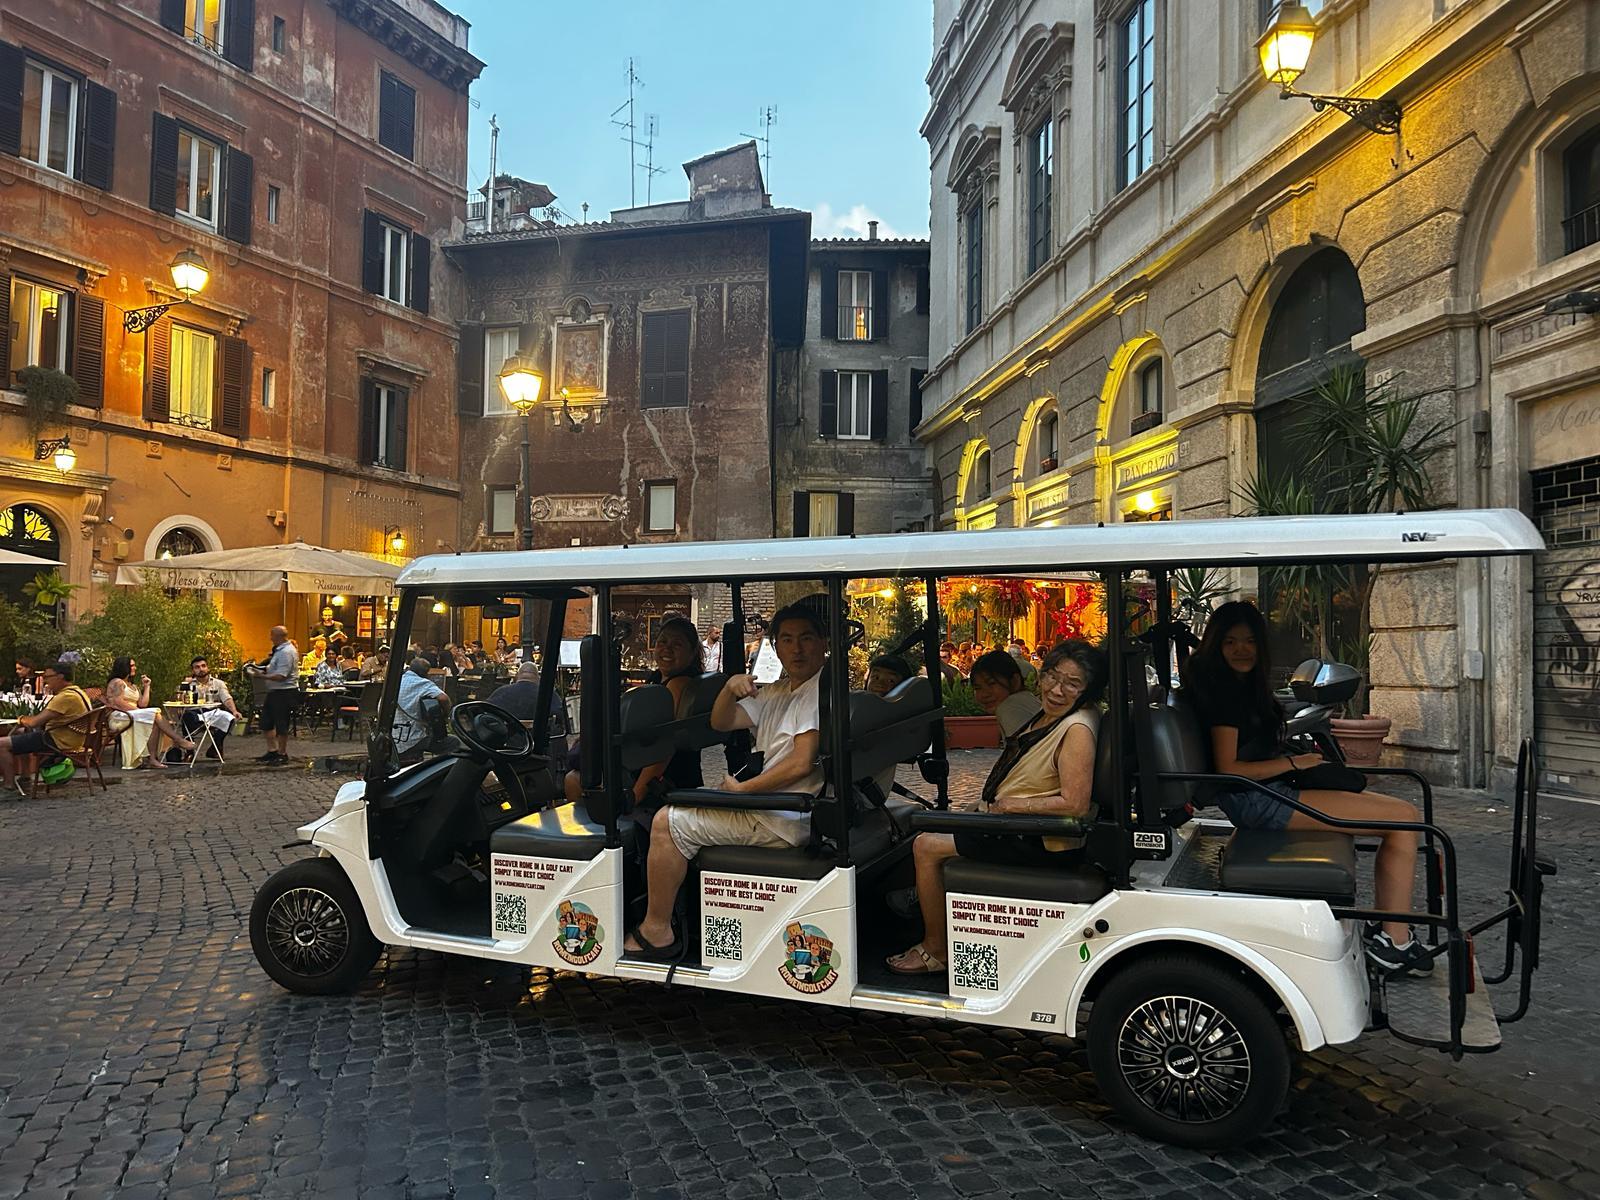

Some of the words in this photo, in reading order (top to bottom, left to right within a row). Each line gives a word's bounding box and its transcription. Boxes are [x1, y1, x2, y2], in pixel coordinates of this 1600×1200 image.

[1125, 452, 1175, 482] PANCRAZIO
[206, 572, 230, 588] Sera
[314, 578, 354, 592] Ristorante
[1136, 834, 1163, 843] zero
[494, 859, 518, 867] DISCOVER
[560, 865, 573, 873] CART
[495, 868, 511, 876] SIMPLY
[537, 872, 554, 880] CHOICE
[705, 878, 732, 887] DISCOVER
[734, 880, 749, 889] ROME
[766, 883, 779, 892] GOLF
[782, 885, 797, 894] CART
[705, 887, 724, 896] SIMPLY
[739, 891, 753, 899] BEST
[755, 892, 775, 901] CHOICE
[705, 901, 764, 912] WWW.ROMEINGOLFCART.COM
[952, 901, 985, 911] DISCOVER
[988, 904, 1007, 913] ROME
[1009, 906, 1016, 914] IN
[1026, 908, 1043, 917] GOLF
[1046, 910, 1065, 919] CART
[952, 911, 976, 921] SIMPLY
[979, 914, 991, 923] THE
[994, 916, 1011, 924] BEST
[1014, 917, 1038, 927] CHOICE
[953, 925, 1024, 938] WWW.ROMEINGOLFCART.COM
[552, 939, 602, 964] ROMEINGOLFCART
[780, 965, 837, 993] ROMEINGOLFCART
[1035, 1013, 1052, 1022] 378
